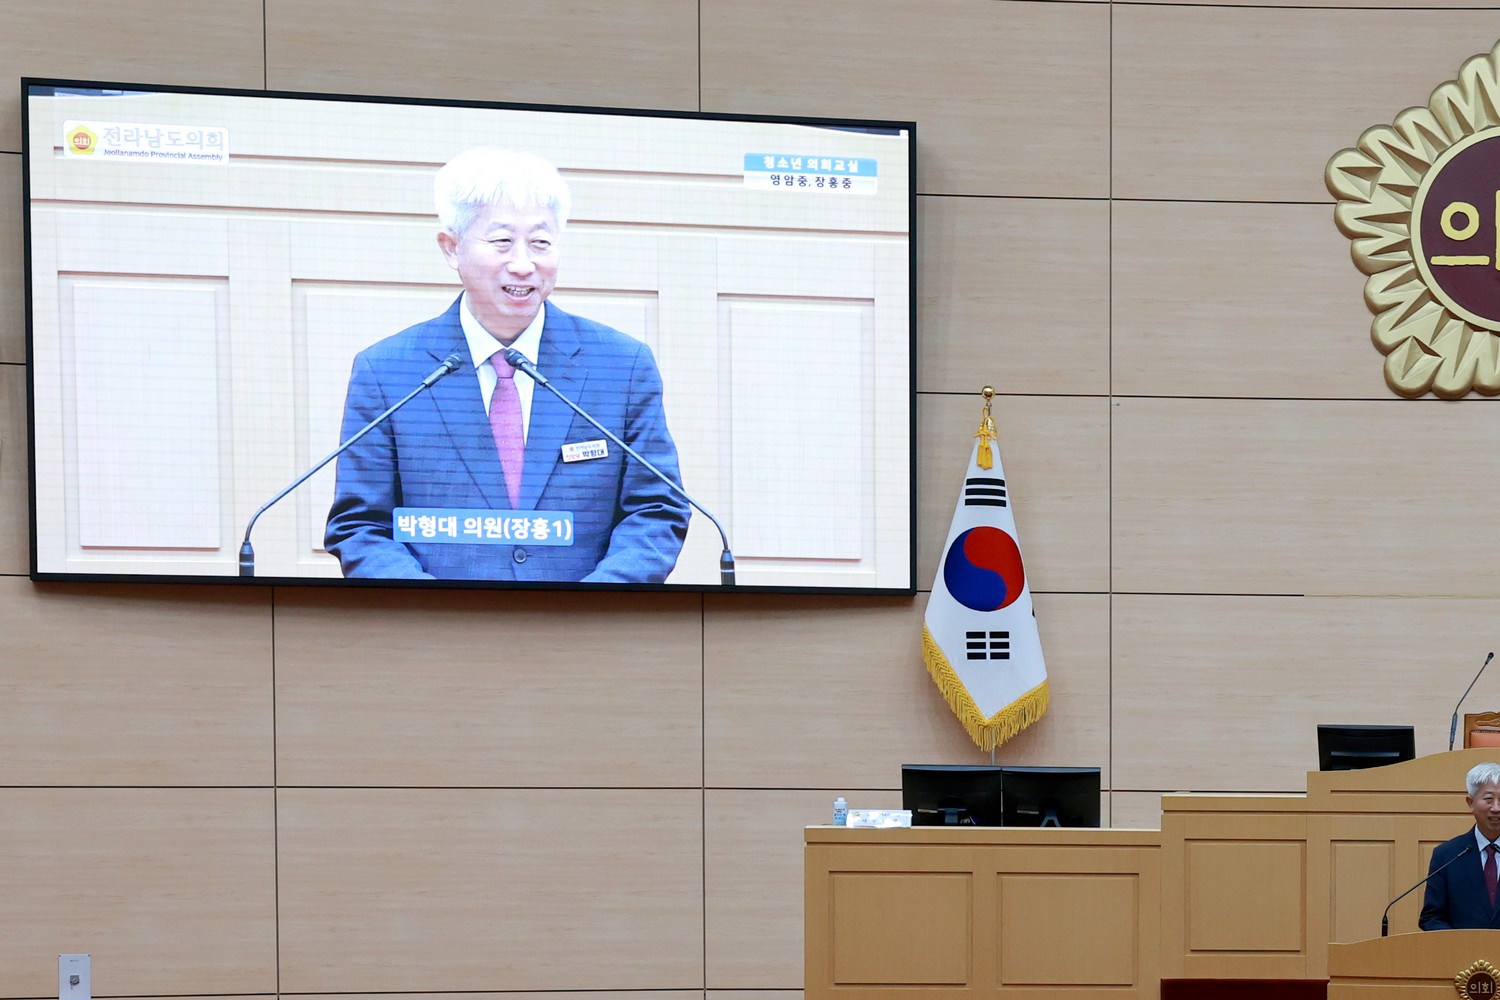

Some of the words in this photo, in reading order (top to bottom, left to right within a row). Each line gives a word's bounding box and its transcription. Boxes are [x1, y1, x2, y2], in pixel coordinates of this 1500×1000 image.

[103, 126, 224, 151] 전라남도의회
[763, 155, 803, 171] 청소년
[806, 158, 859, 173] 의회교실
[397, 515, 458, 538] 박형대
[463, 516, 572, 541] 의원(장흥1)
[1469, 980, 1493, 994] 의회
